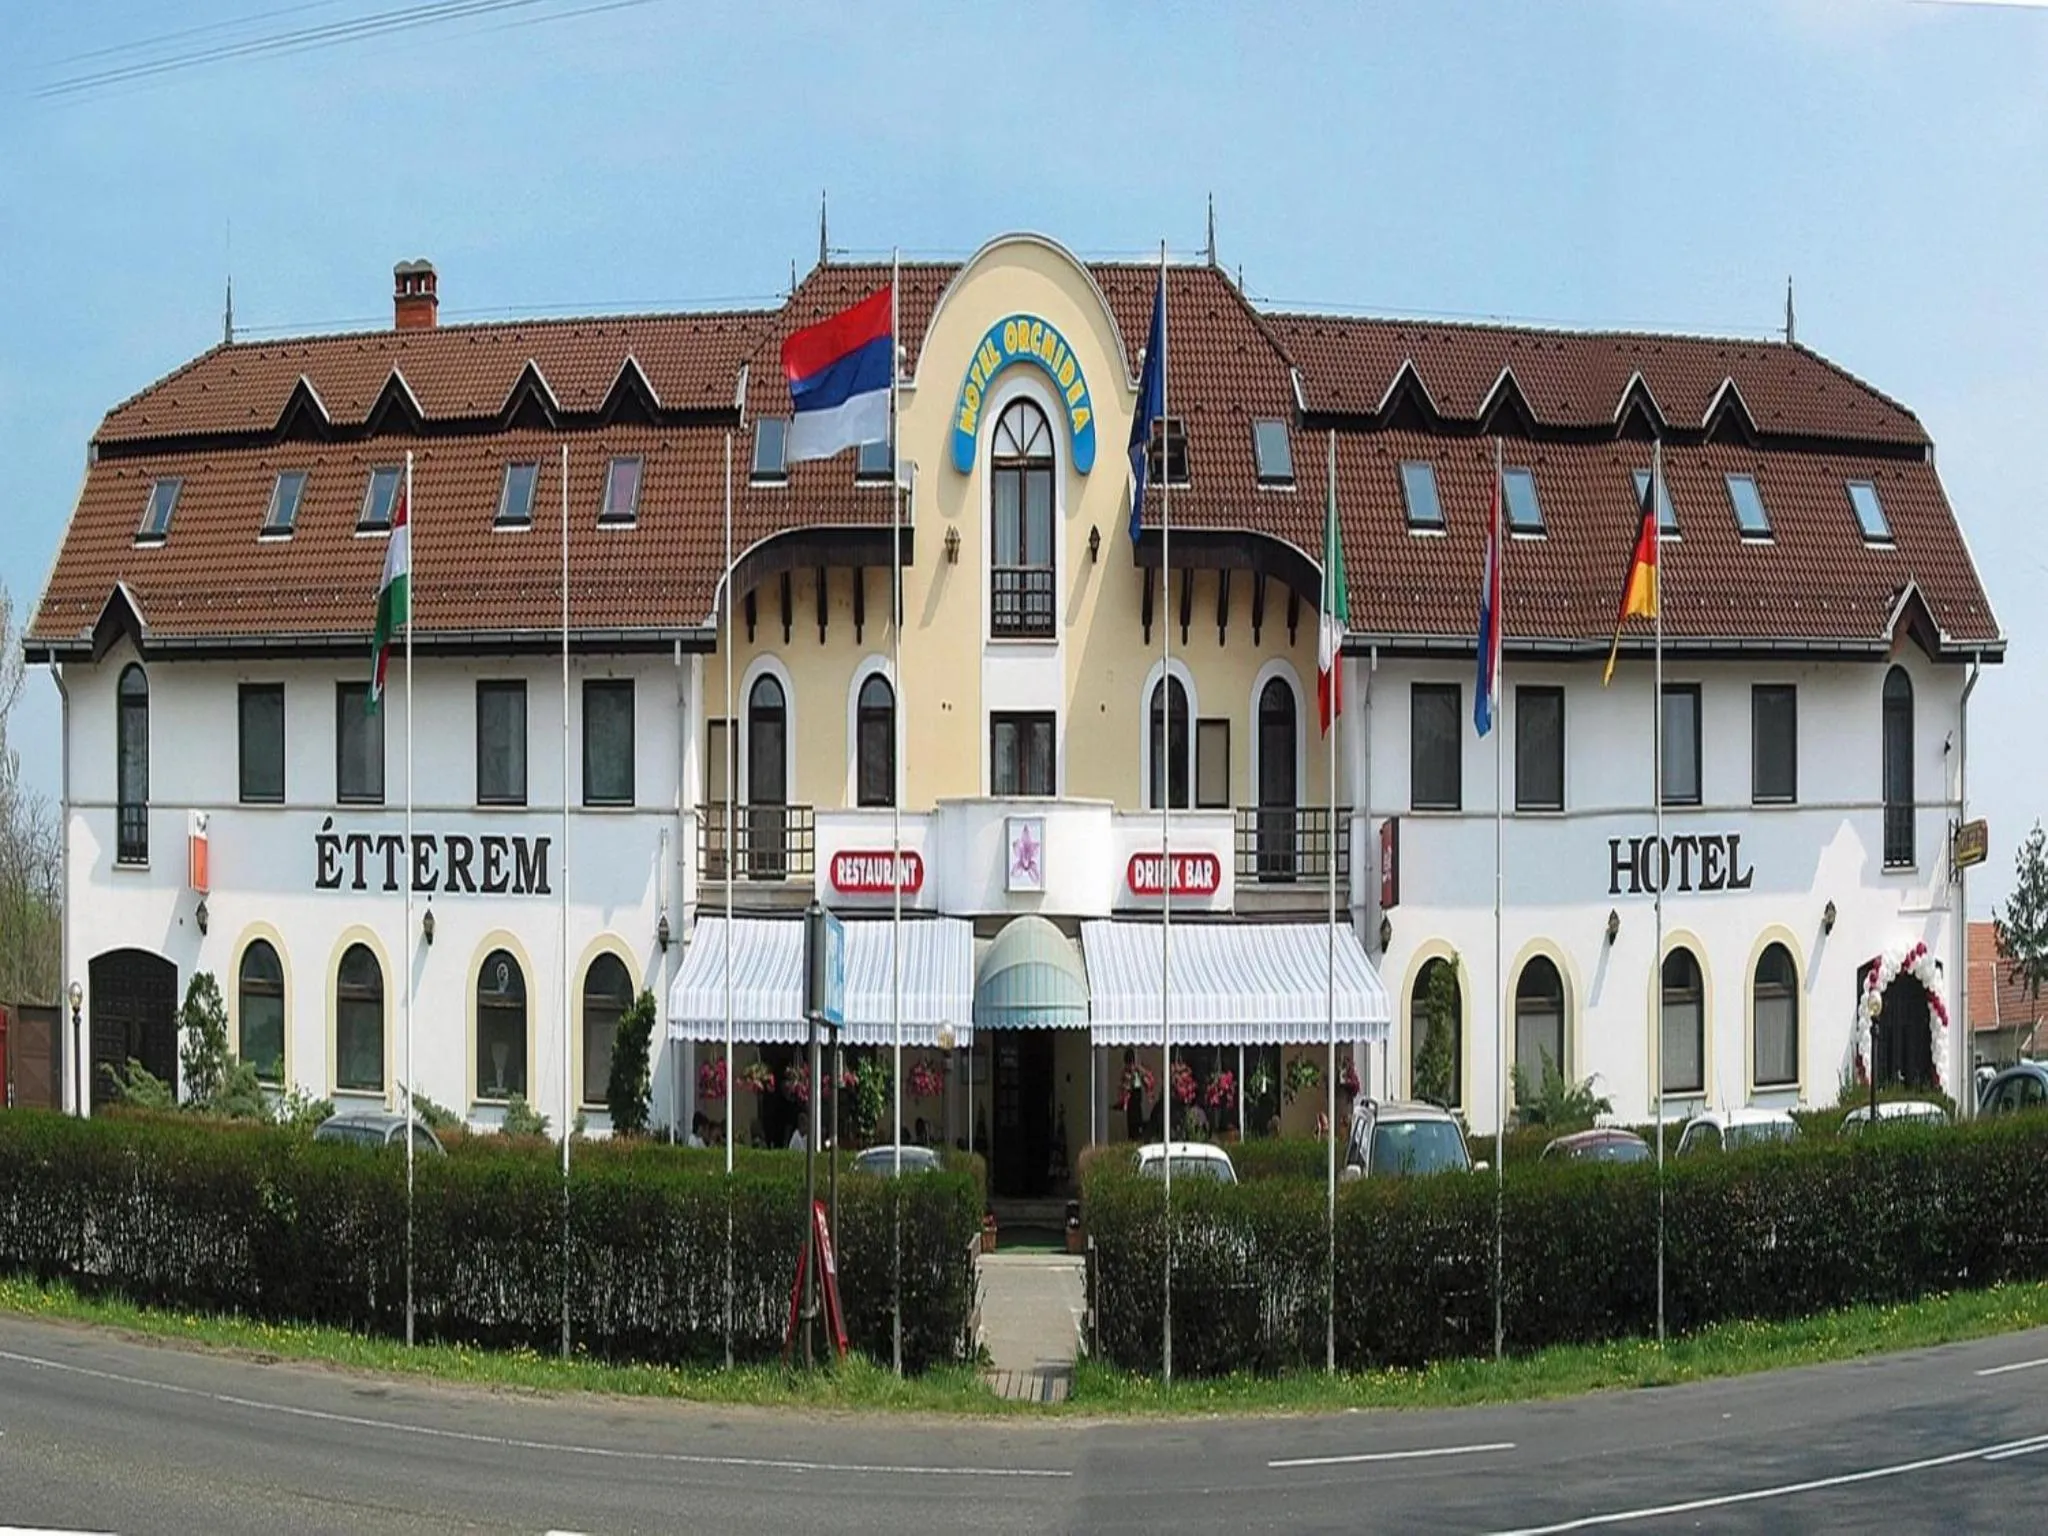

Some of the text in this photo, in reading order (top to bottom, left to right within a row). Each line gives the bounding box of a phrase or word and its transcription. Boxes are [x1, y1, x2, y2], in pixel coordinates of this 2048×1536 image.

[959, 320, 1091, 437] HOTEL ORCHIDEA
[315, 815, 552, 895] ÉTTEREM
[1185, 859, 1214, 889] BAR
[1607, 834, 1754, 895] HOTEL
